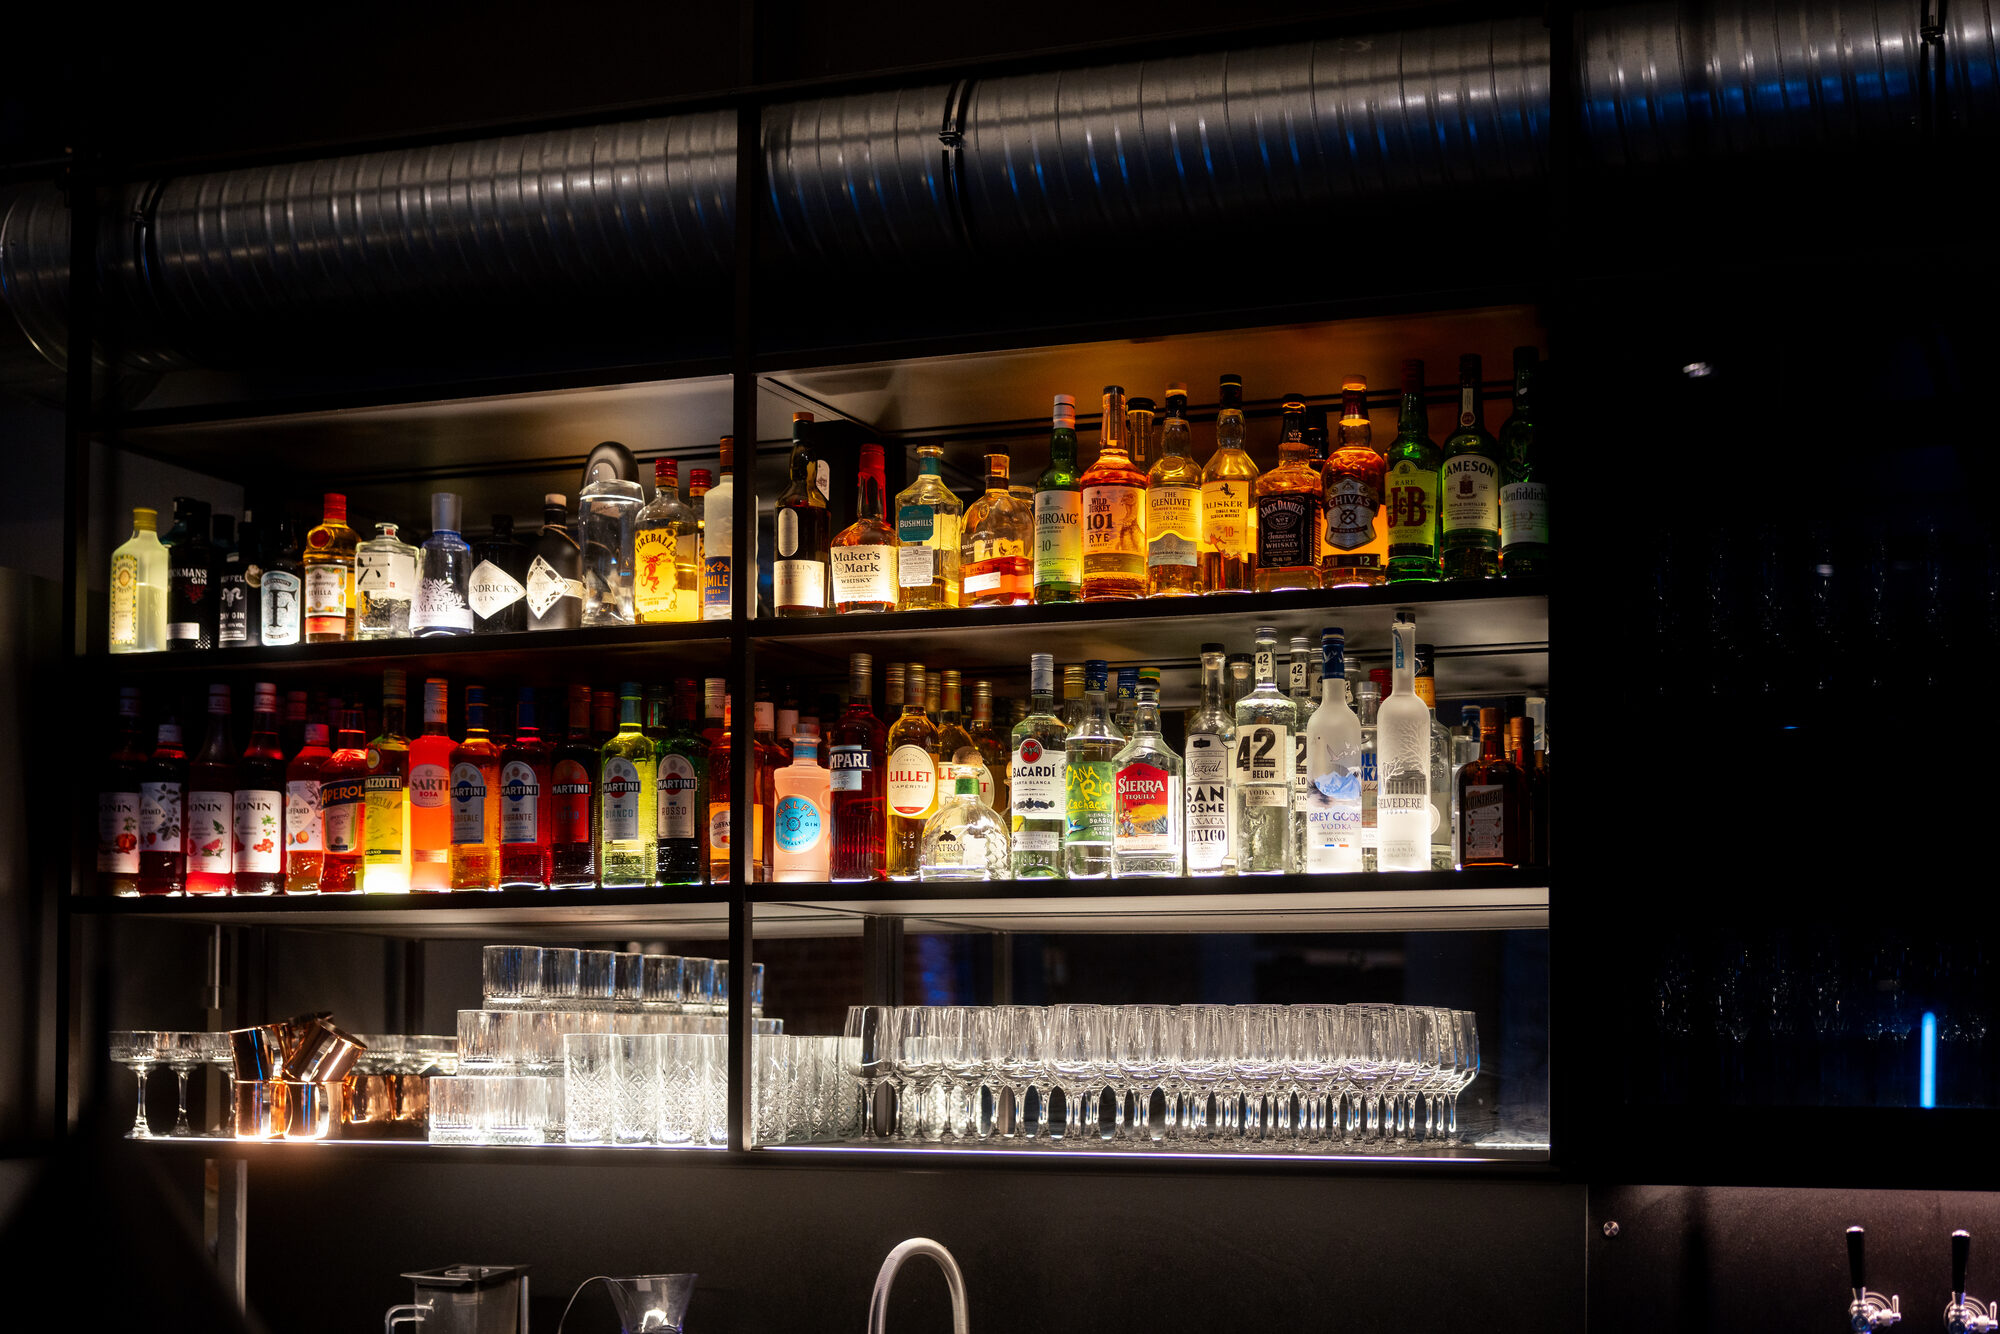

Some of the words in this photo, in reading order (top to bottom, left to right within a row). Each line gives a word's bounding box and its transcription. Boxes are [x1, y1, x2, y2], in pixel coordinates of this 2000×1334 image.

[1443, 460, 1495, 480] JAMESON
[1151, 498, 1191, 508] GLENLIVET
[1328, 494, 1371, 508] CHIVAS
[1088, 504, 1110, 513] TURKEY
[1260, 502, 1277, 518] JACK
[899, 518, 934, 528] BUSHMILLS
[1036, 512, 1077, 526] PHROAIG
[1087, 513, 1114, 531] 101
[1223, 526, 1234, 537] 10
[1089, 533, 1110, 543] RYE
[1041, 539, 1052, 552] 10
[833, 551, 881, 562] Maker's
[1359, 556, 1370, 565] 12
[169, 568, 208, 579] CKMANS
[844, 563, 881, 573] Mark
[268, 588, 298, 627] F
[231, 612, 245, 620] GIN
[1257, 653, 1269, 665] 42
[1291, 663, 1303, 675] 42
[1236, 727, 1276, 771] 42
[1296, 735, 1307, 774] 2
[829, 752, 870, 769] MPARI.
[889, 770, 932, 782] LILLET
[1012, 764, 1056, 778] BACARDÍ
[1252, 770, 1275, 779] BELOW
[365, 777, 400, 789] AZZOTTI
[411, 778, 449, 791] SARTI
[603, 782, 639, 792] MARTINI
[658, 779, 694, 790] MARTINI
[1117, 776, 1164, 794] SIERRA
[552, 784, 589, 794] MARTINI
[1186, 785, 1224, 803] SAN
[321, 785, 365, 806] APEROL
[100, 803, 132, 813] ONIN
[189, 802, 222, 812] ONIN
[661, 806, 687, 816] ROSSO
[777, 800, 817, 818] MALFY
[1187, 803, 1225, 814] OSME
[605, 808, 634, 819] BIANCO
[1309, 812, 1330, 822] GREY
[1191, 817, 1225, 825] AXACA
[1188, 829, 1226, 843] EXICO
[929, 841, 966, 852] PATRÓN
